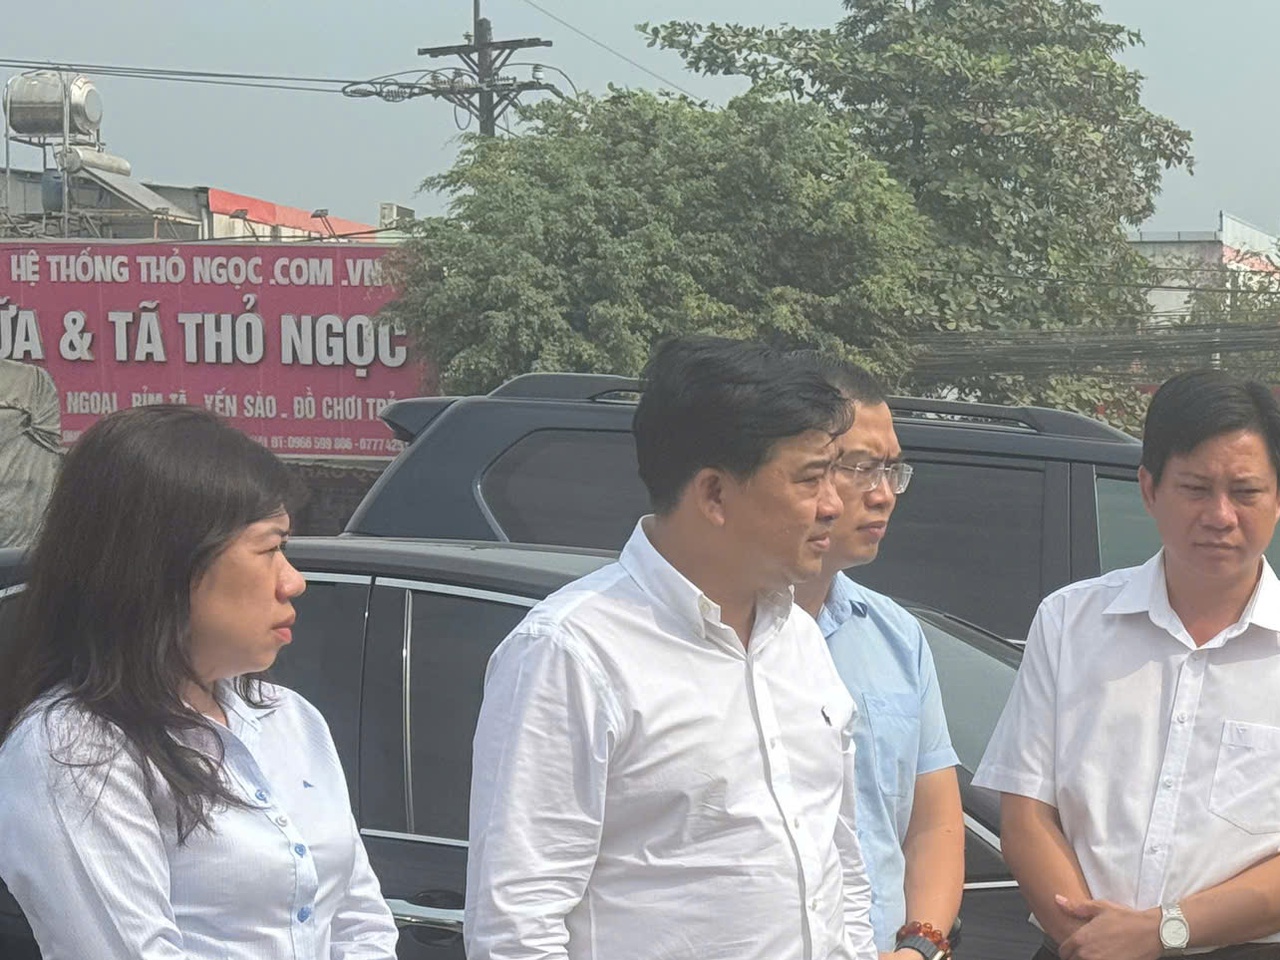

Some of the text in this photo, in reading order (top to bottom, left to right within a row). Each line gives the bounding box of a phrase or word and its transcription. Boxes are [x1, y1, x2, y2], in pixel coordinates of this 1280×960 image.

[10, 250, 40, 287] HỆ
[47, 247, 130, 284] THỐNG
[136, 248, 186, 285] THỎ
[193, 256, 264, 290] NGỌC
[59, 310, 95, 361] &
[108, 300, 168, 363] TÃ
[177, 293, 266, 364] THỎ
[281, 313, 407, 378] NGỌC
[243, 391, 277, 418] SÀO
[322, 396, 362, 420] CHƠI
